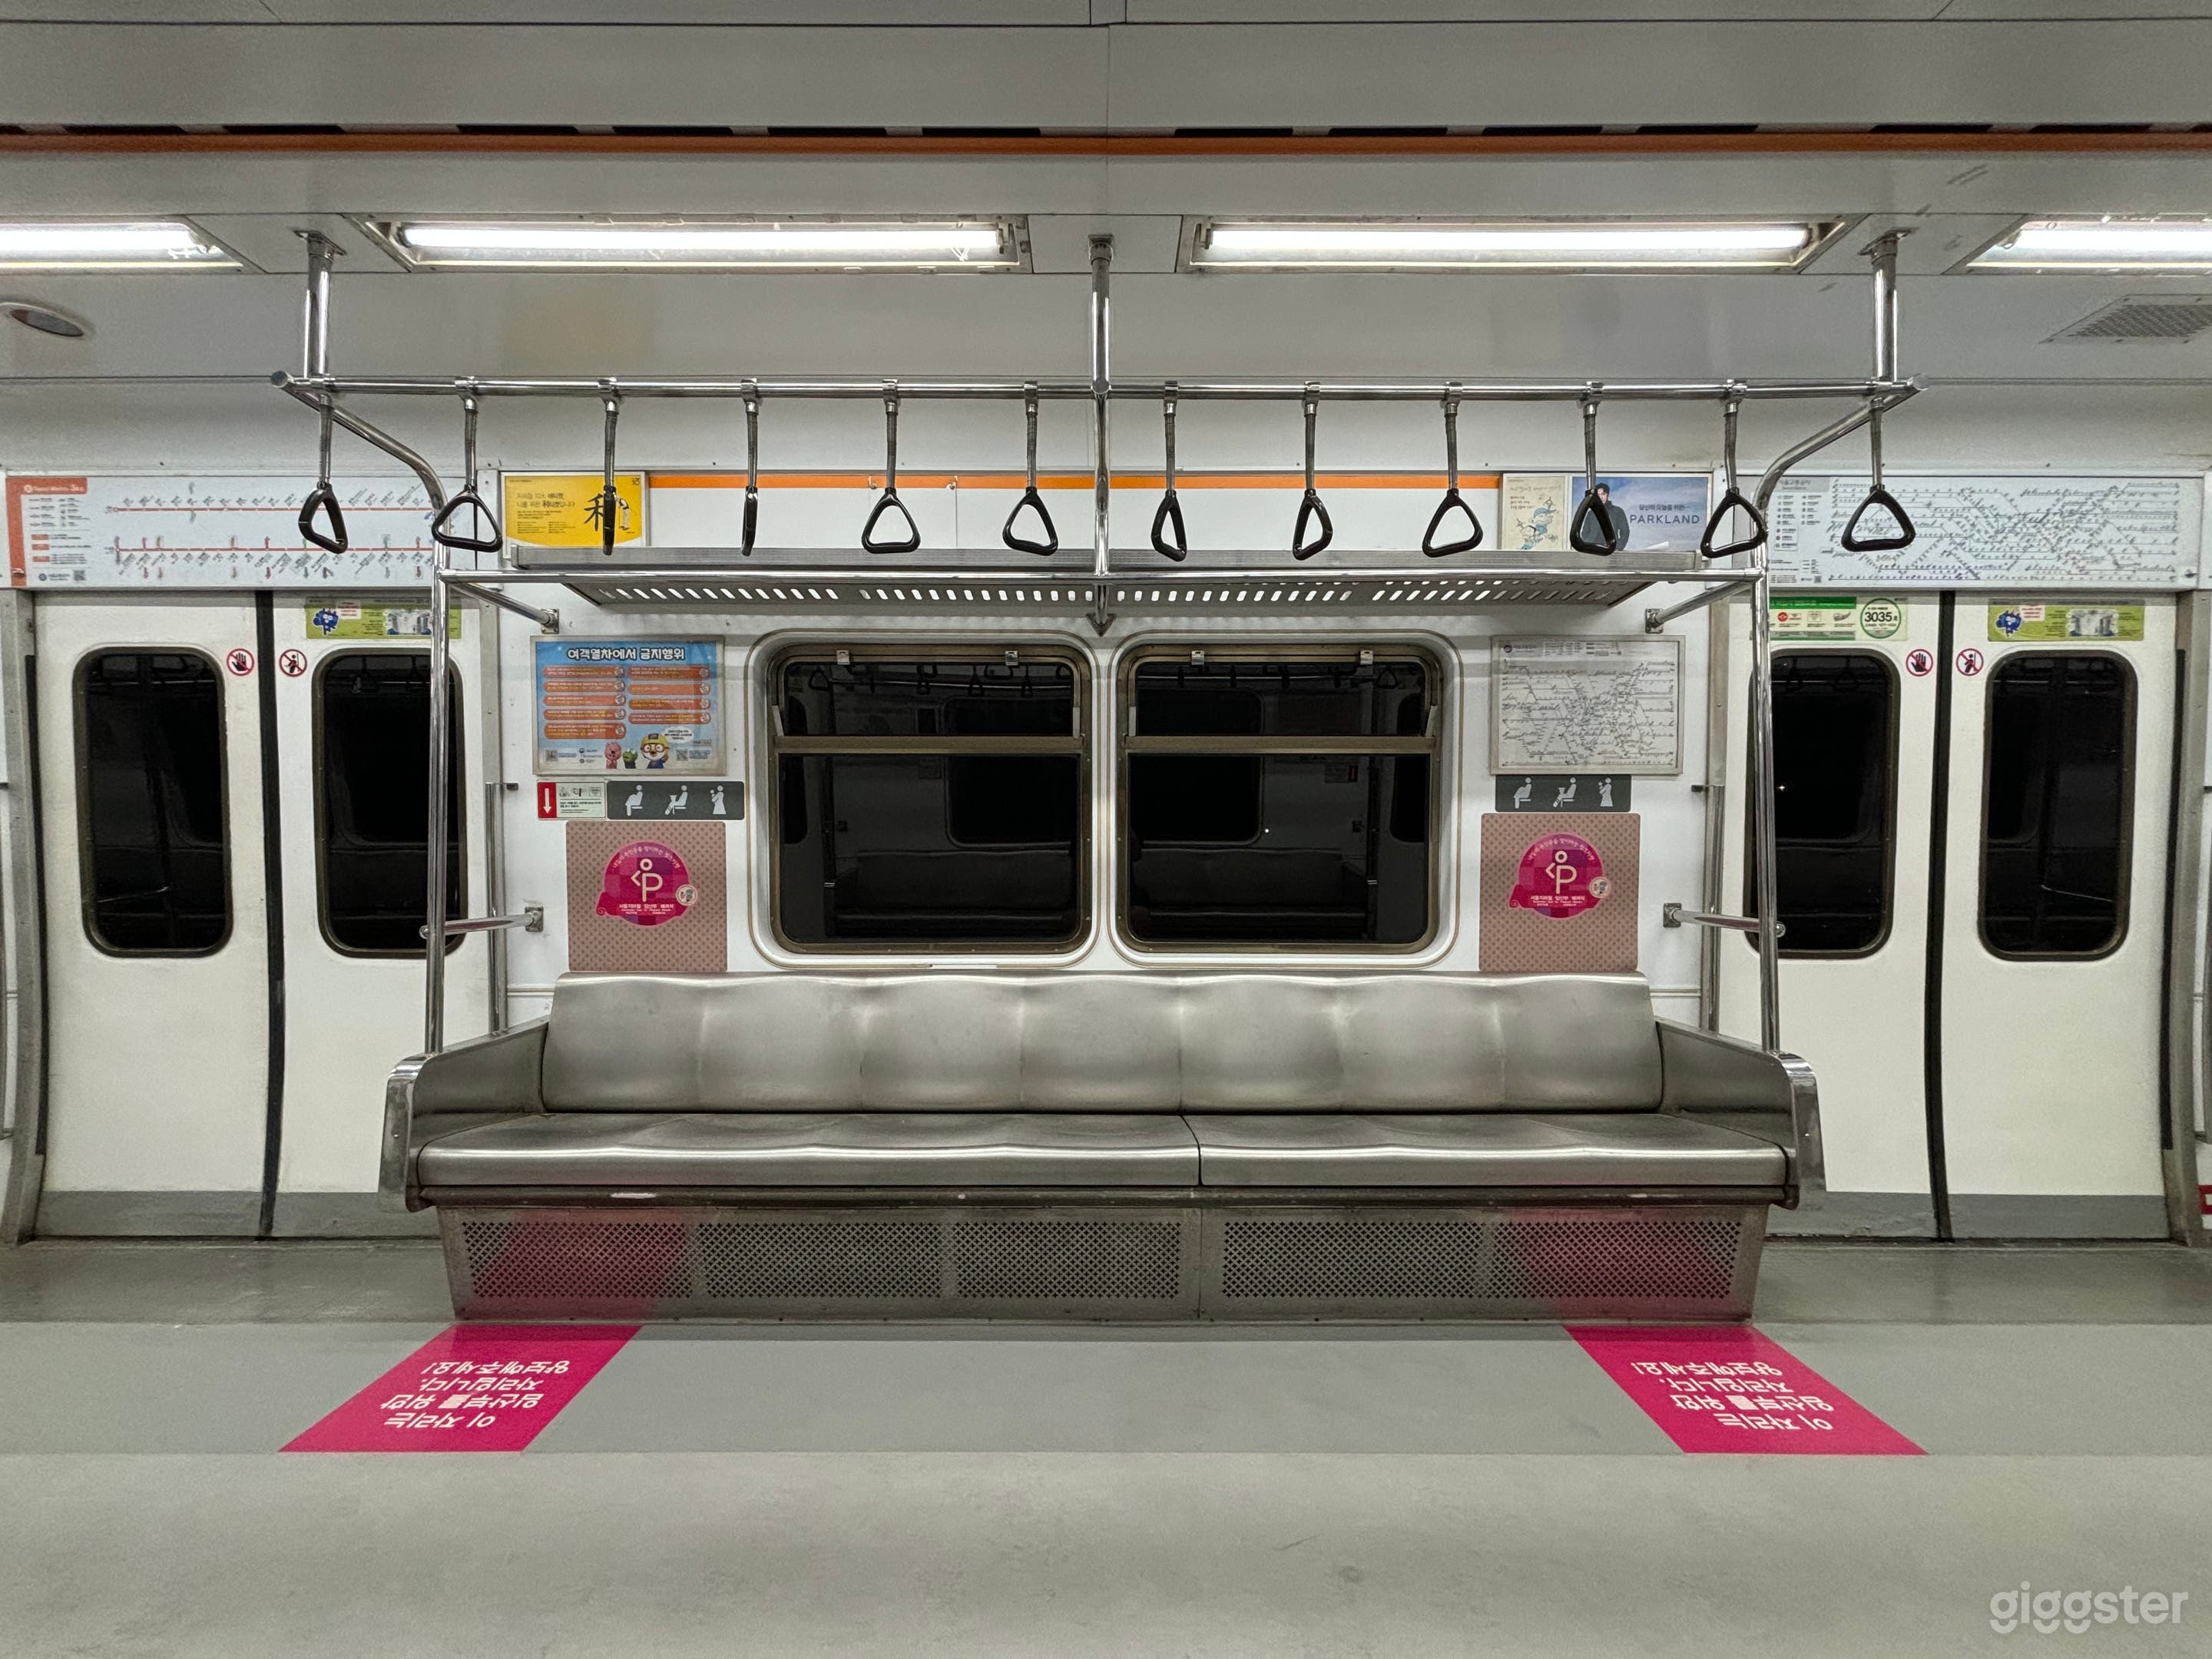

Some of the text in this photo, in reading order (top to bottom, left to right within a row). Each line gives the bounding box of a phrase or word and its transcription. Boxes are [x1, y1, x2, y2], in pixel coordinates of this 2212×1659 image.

[1629, 515, 1700, 524] PARKLAND
[1864, 611, 1892, 622] 3035
[568, 647, 685, 661] 여객열차에서 금지행위
[419, 1360, 570, 1375] 양보해주세요!
[1631, 1361, 1783, 1376] 양보해주세요!
[419, 1376, 544, 1392] 자리입니다.
[1659, 1377, 1795, 1393] 자리입니다.
[380, 1392, 544, 1410] 임산부를 위한
[1670, 1394, 1835, 1412] 임산부를 위한
[383, 1412, 496, 1429] 이 자리는
[1713, 1413, 1833, 1431] 이 자리는
